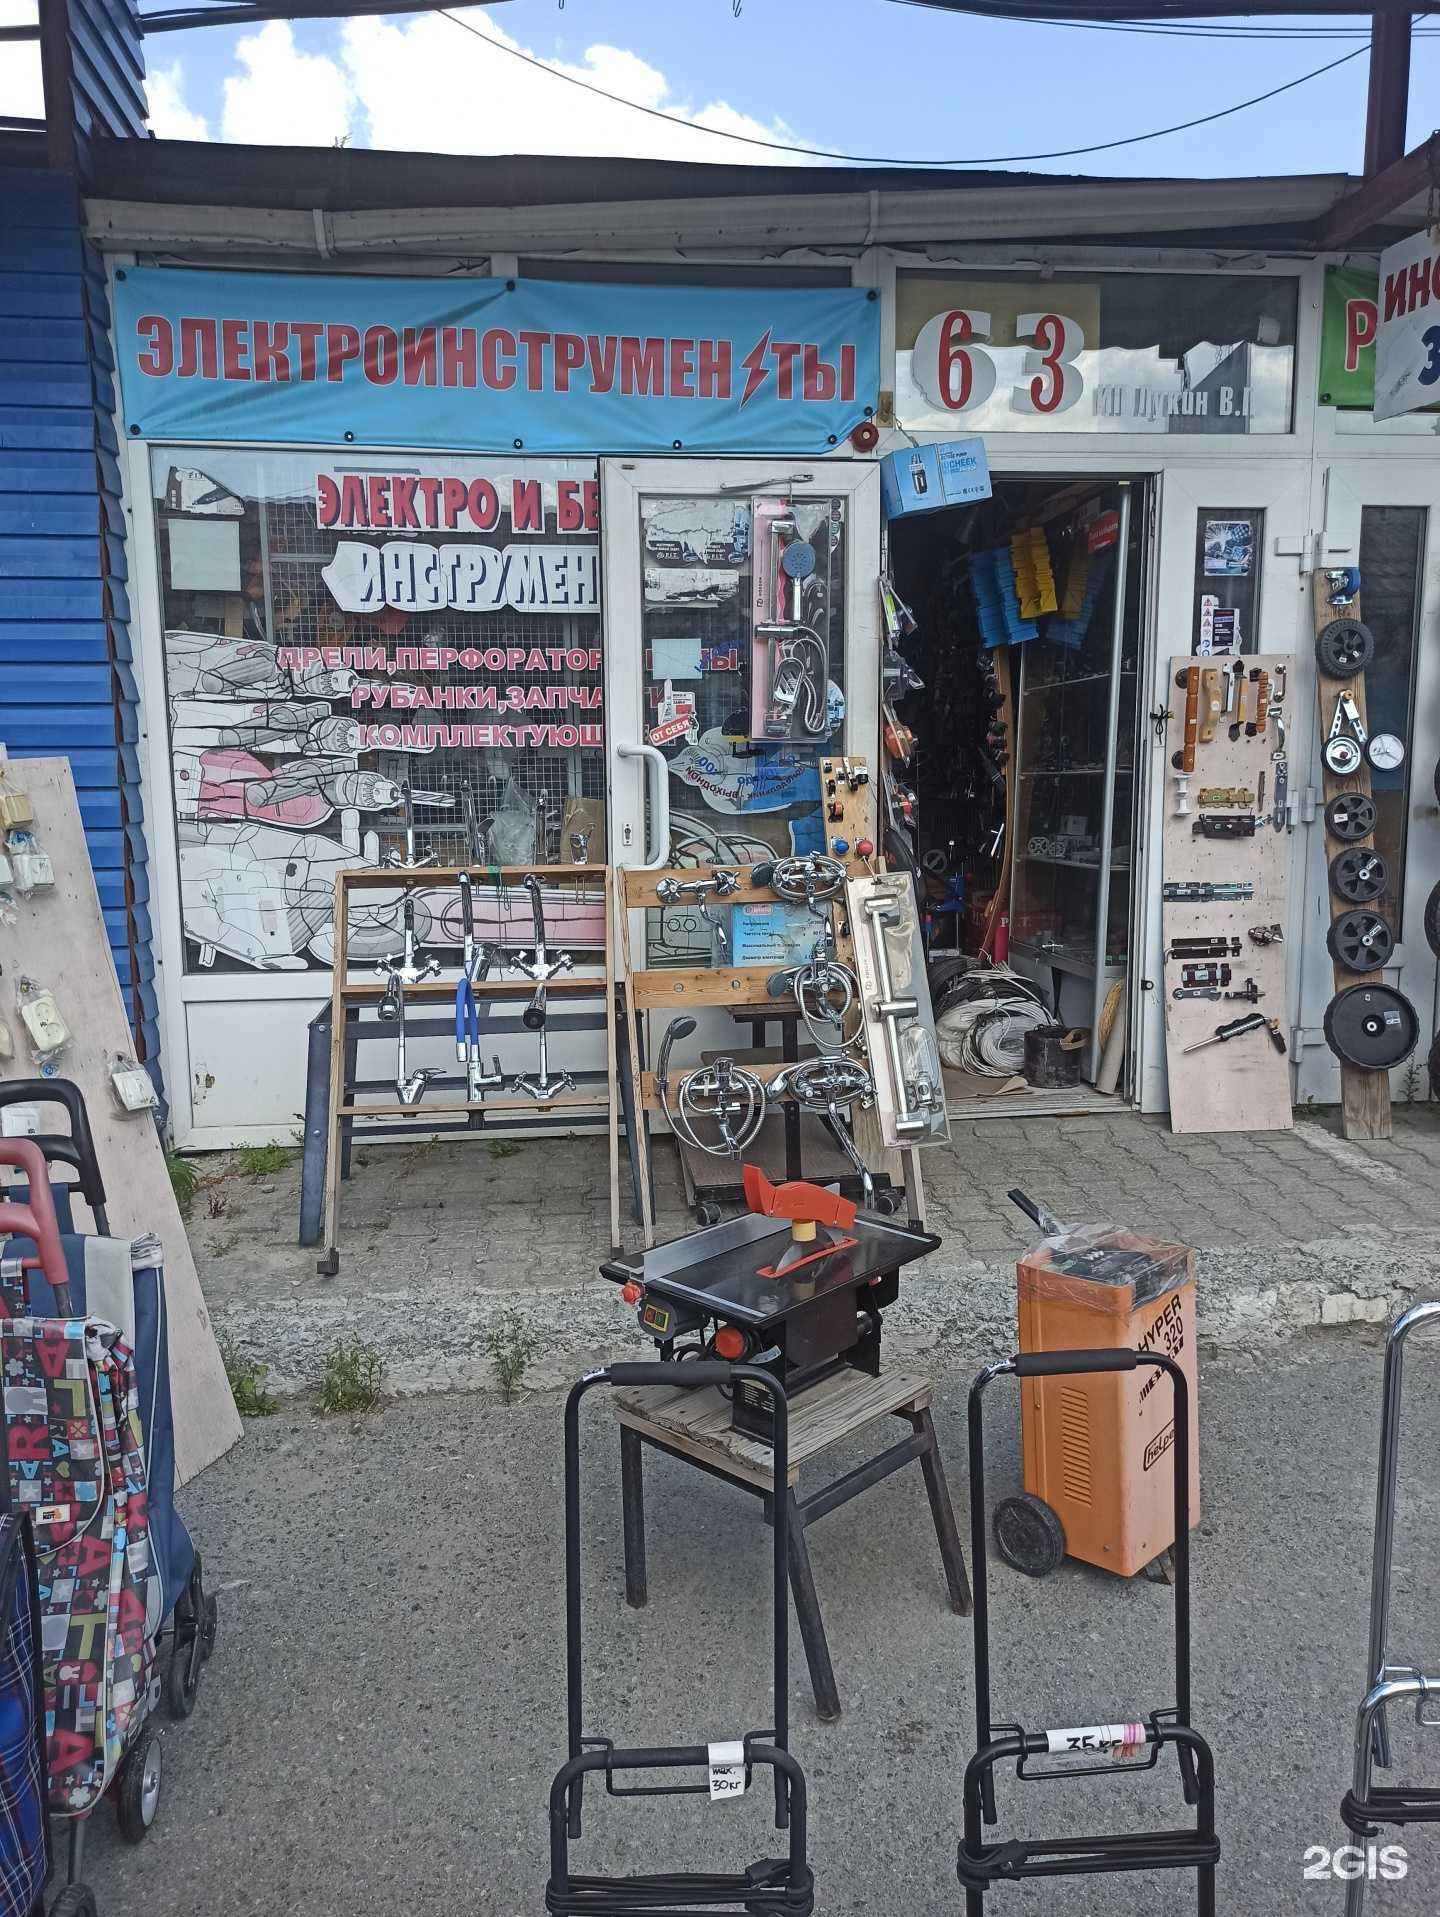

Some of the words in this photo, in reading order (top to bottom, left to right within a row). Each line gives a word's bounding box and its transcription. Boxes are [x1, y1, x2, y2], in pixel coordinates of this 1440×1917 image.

[317, 474, 500, 529] ЭЛЕКТРО
[513, 479, 543, 531] И
[651, 729, 664, 742] ОТ
[665, 716, 690, 735] СЕБЯ
[1138, 1294, 1182, 1352] HYPER
[1164, 1315, 1184, 1350] 320
